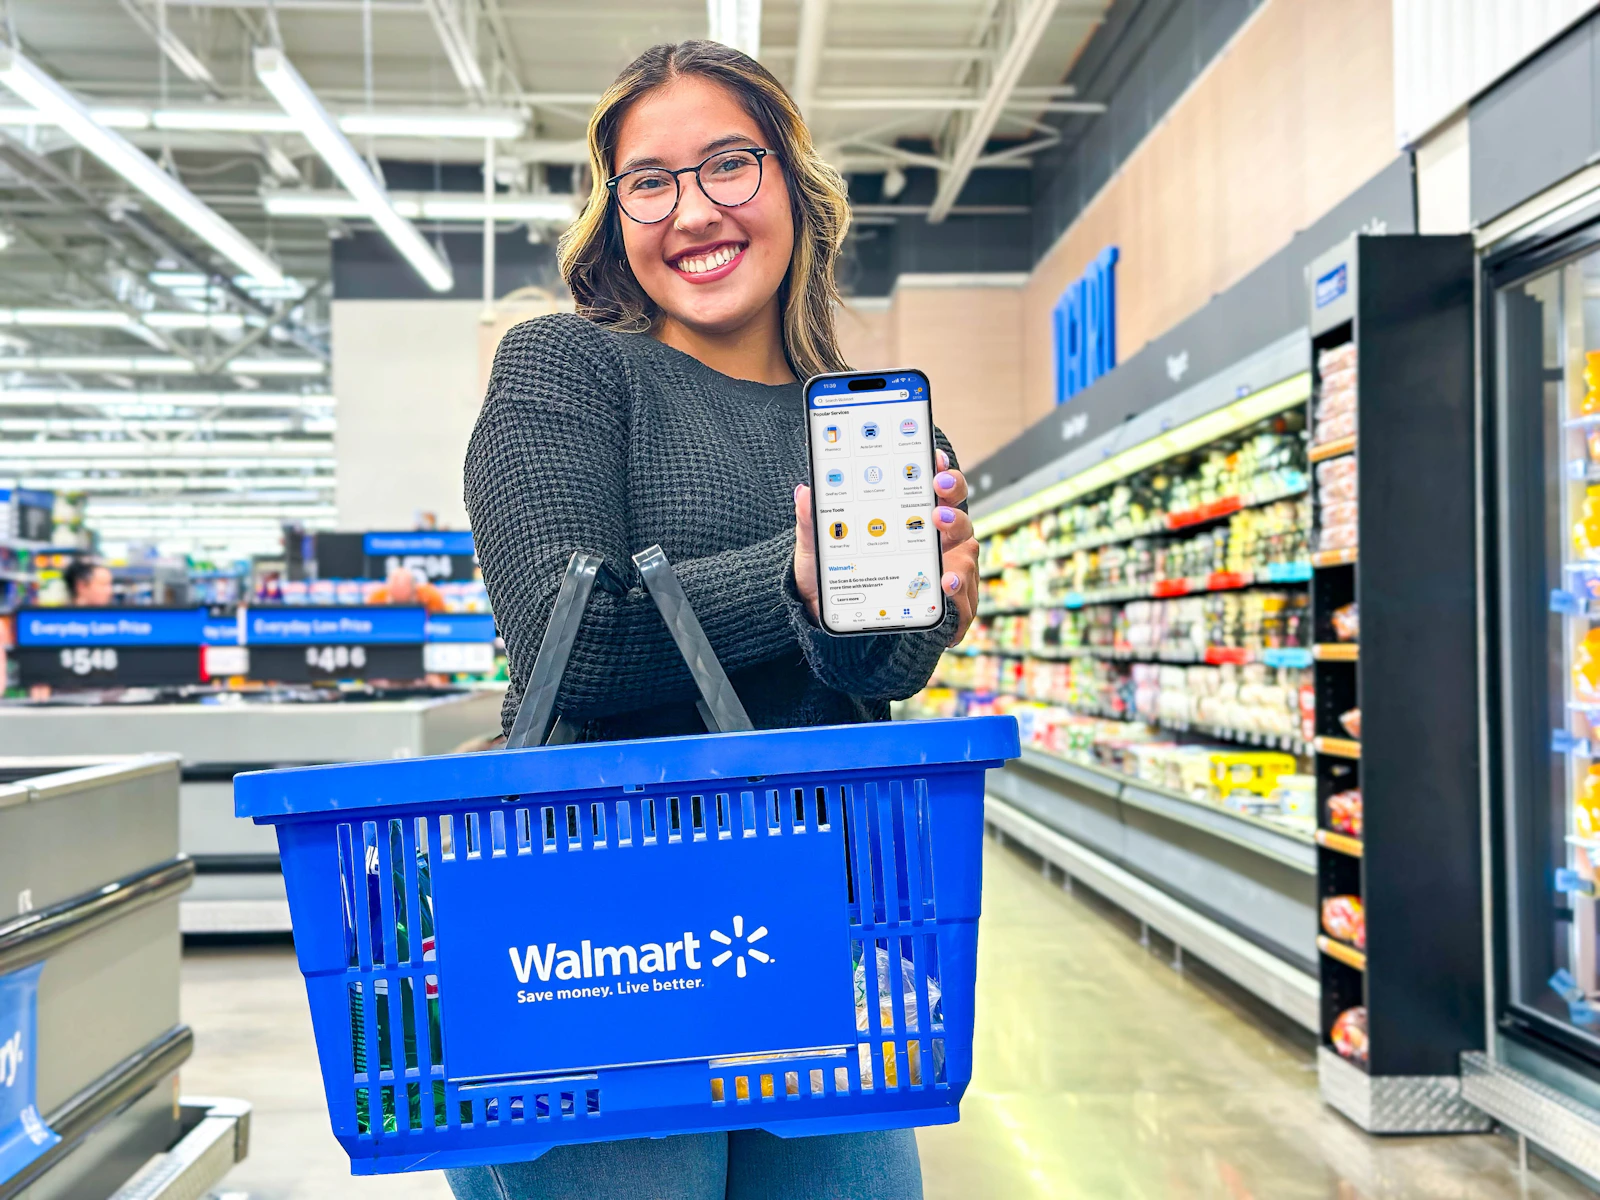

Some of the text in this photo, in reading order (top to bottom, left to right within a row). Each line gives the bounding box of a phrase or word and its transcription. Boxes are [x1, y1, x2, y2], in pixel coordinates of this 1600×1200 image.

[508, 931, 702, 984] Walmart
[516, 977, 705, 1004] Save money. Live better.
